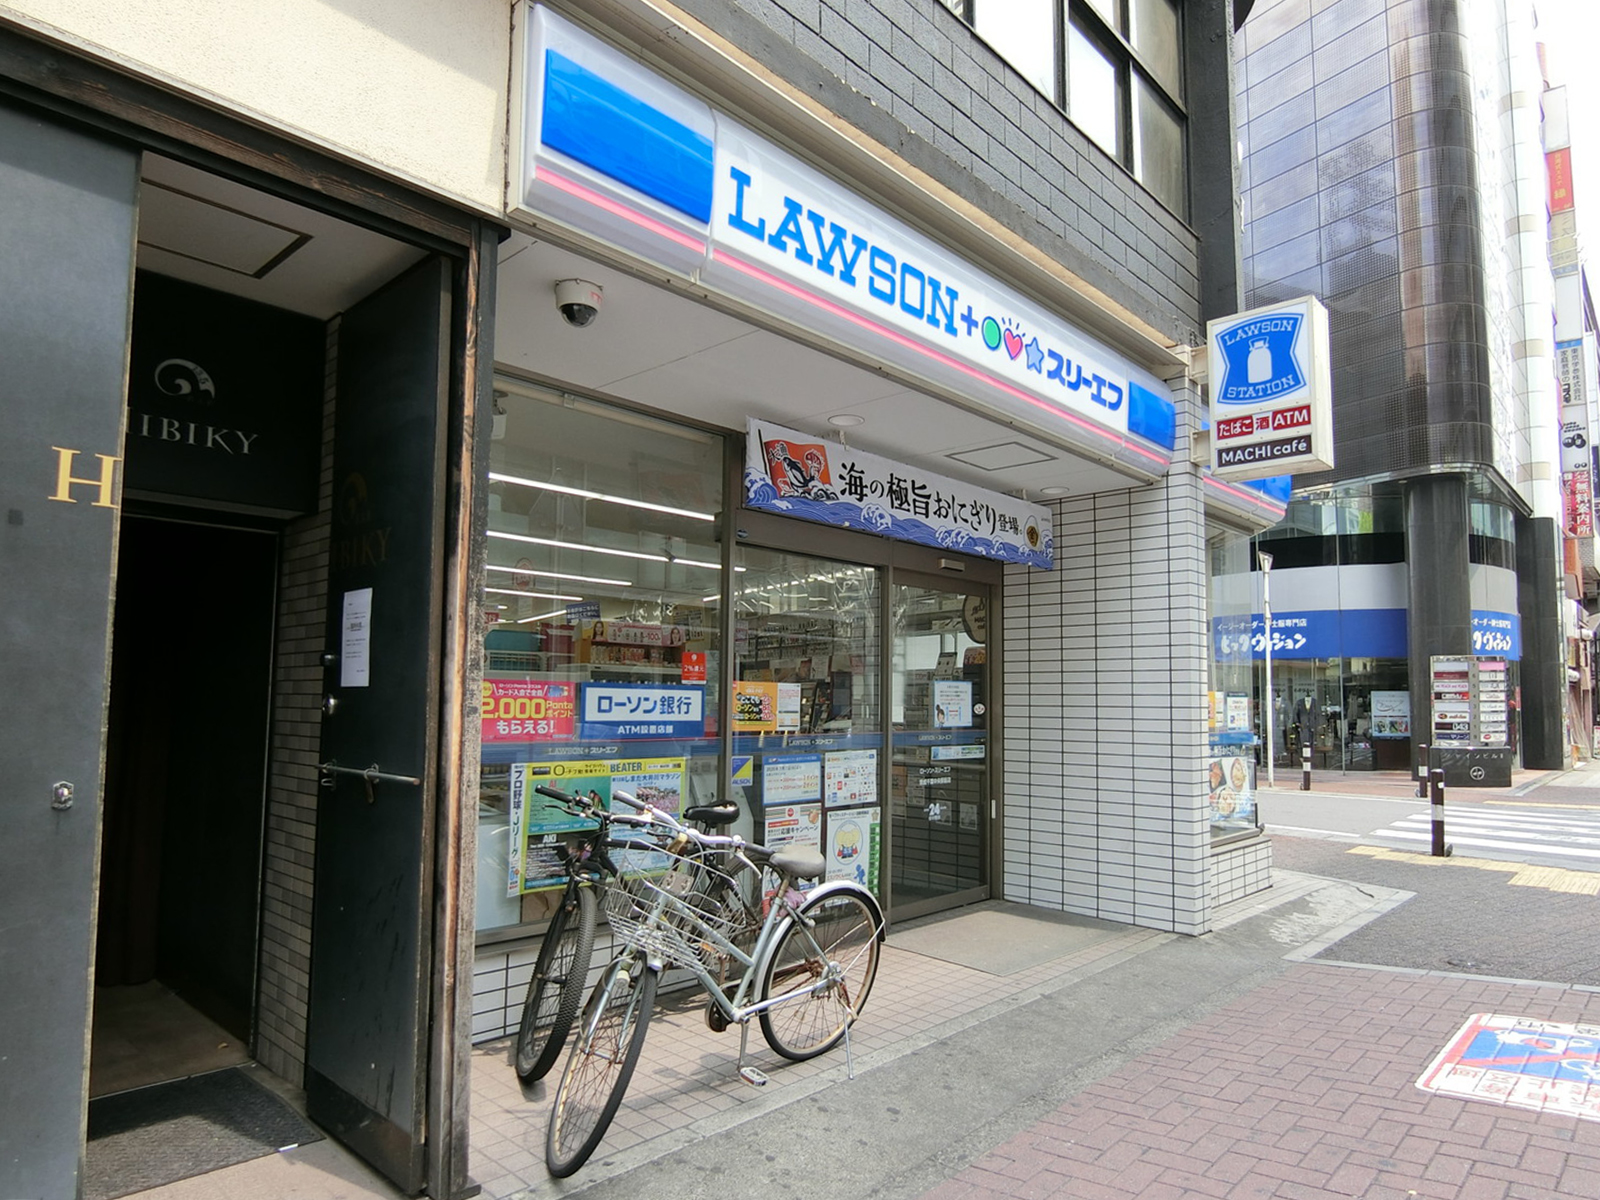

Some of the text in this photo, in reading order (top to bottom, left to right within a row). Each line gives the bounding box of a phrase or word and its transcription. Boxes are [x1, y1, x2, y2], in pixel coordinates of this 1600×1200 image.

[1224, 320, 1294, 346] LAWSON
[1047, 349, 1124, 411] スリーエフ
[1227, 374, 1295, 399] STATION
[1219, 419, 1253, 438] たばこ
[1273, 409, 1308, 427] ATM
[1221, 438, 1307, 464] MACHI café
[48, 446, 122, 508] H
[480, 698, 573, 719] 2,000 Ponta
[546, 710, 573, 718] ポイント
[597, 695, 692, 715] ローソン銀行
[496, 720, 555, 735] もらえる!
[617, 725, 674, 734] ATM設置店舗
[610, 762, 642, 772] BEATER
